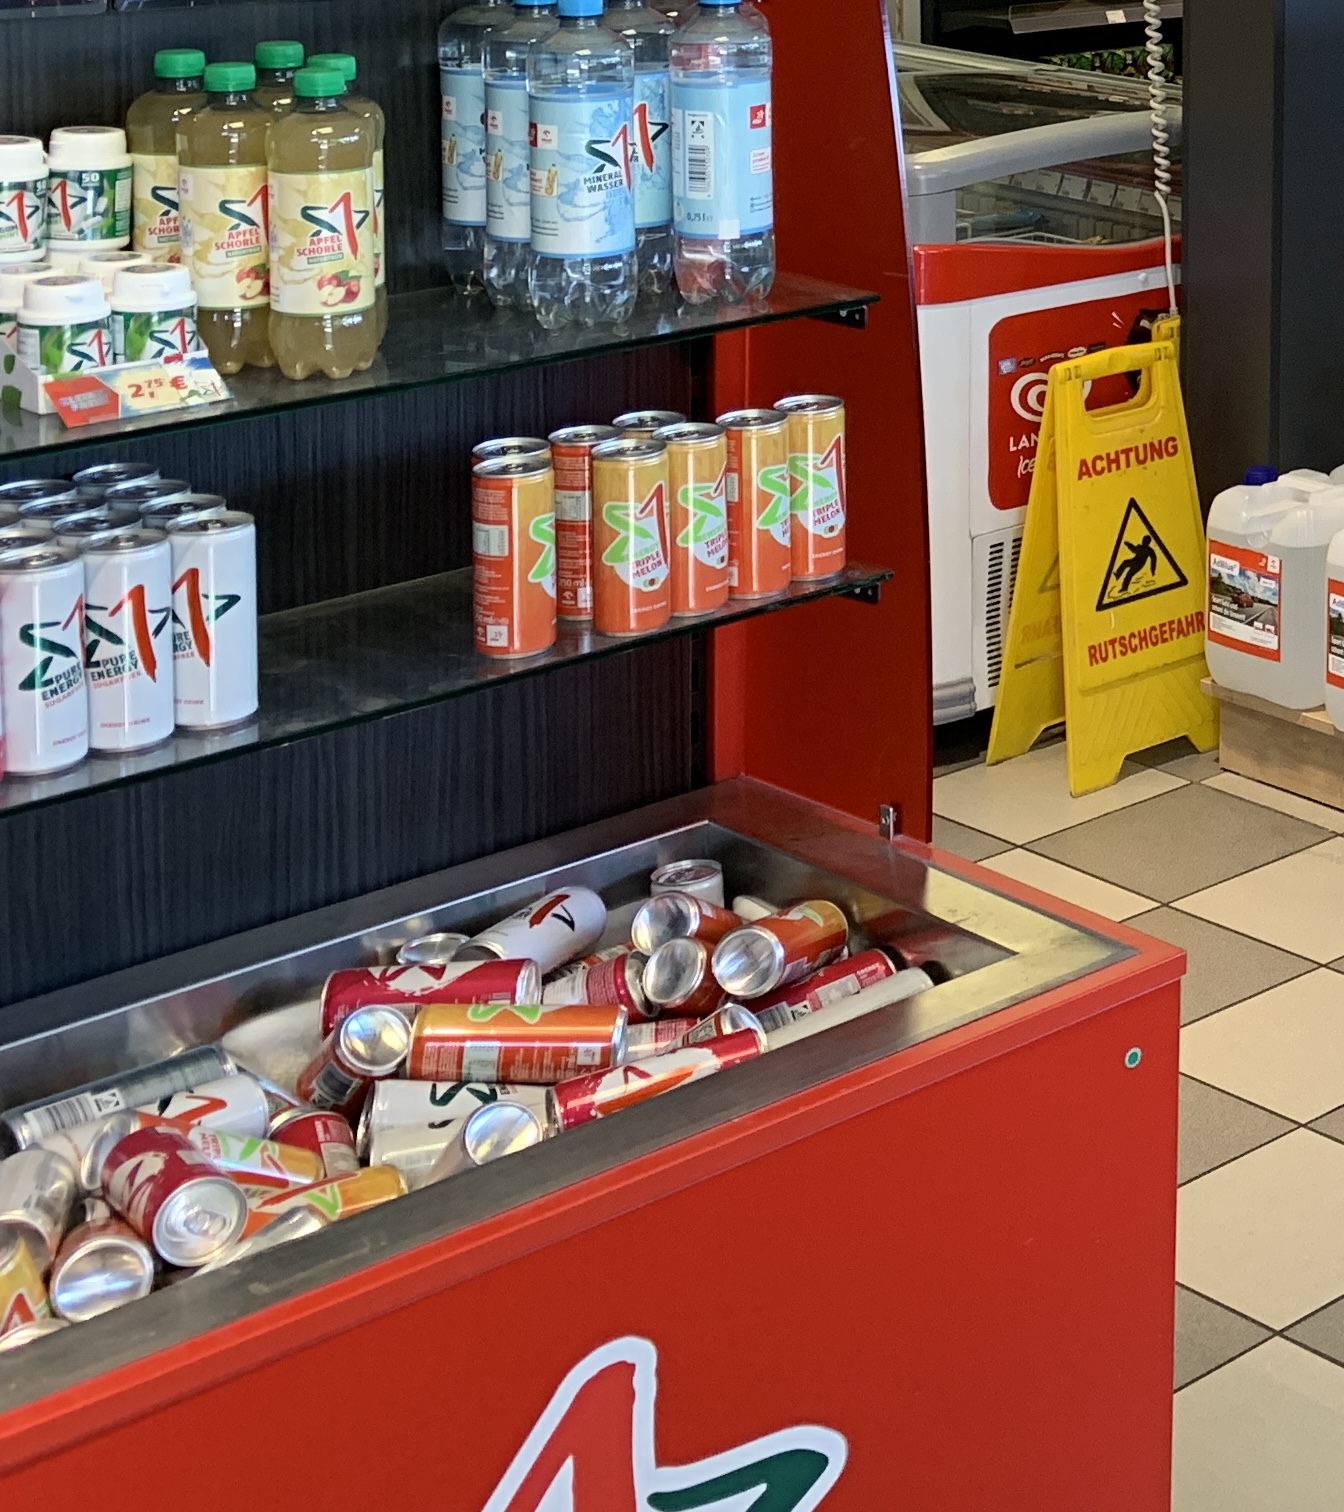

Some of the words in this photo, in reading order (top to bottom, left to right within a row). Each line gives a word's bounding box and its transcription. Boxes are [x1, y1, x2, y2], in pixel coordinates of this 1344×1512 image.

[81, 172, 100, 182] 50
[583, 170, 623, 184] MINERAL
[587, 179, 623, 194] WASSER
[159, 216, 178, 226] APF
[148, 225, 180, 235] SCHOR
[228, 229, 260, 241] APFEL
[214, 238, 260, 251] SCHORLE
[309, 235, 343, 246] APFEL
[296, 245, 343, 257] SCHORLE
[170, 375, 188, 390] €
[1077, 436, 1180, 482] ACHTUNG
[632, 558, 663, 579] MELON
[1087, 608, 1206, 668] RUTSCHGEFAHR
[101, 650, 138, 668] PURE
[90, 659, 139, 682] ENERGY
